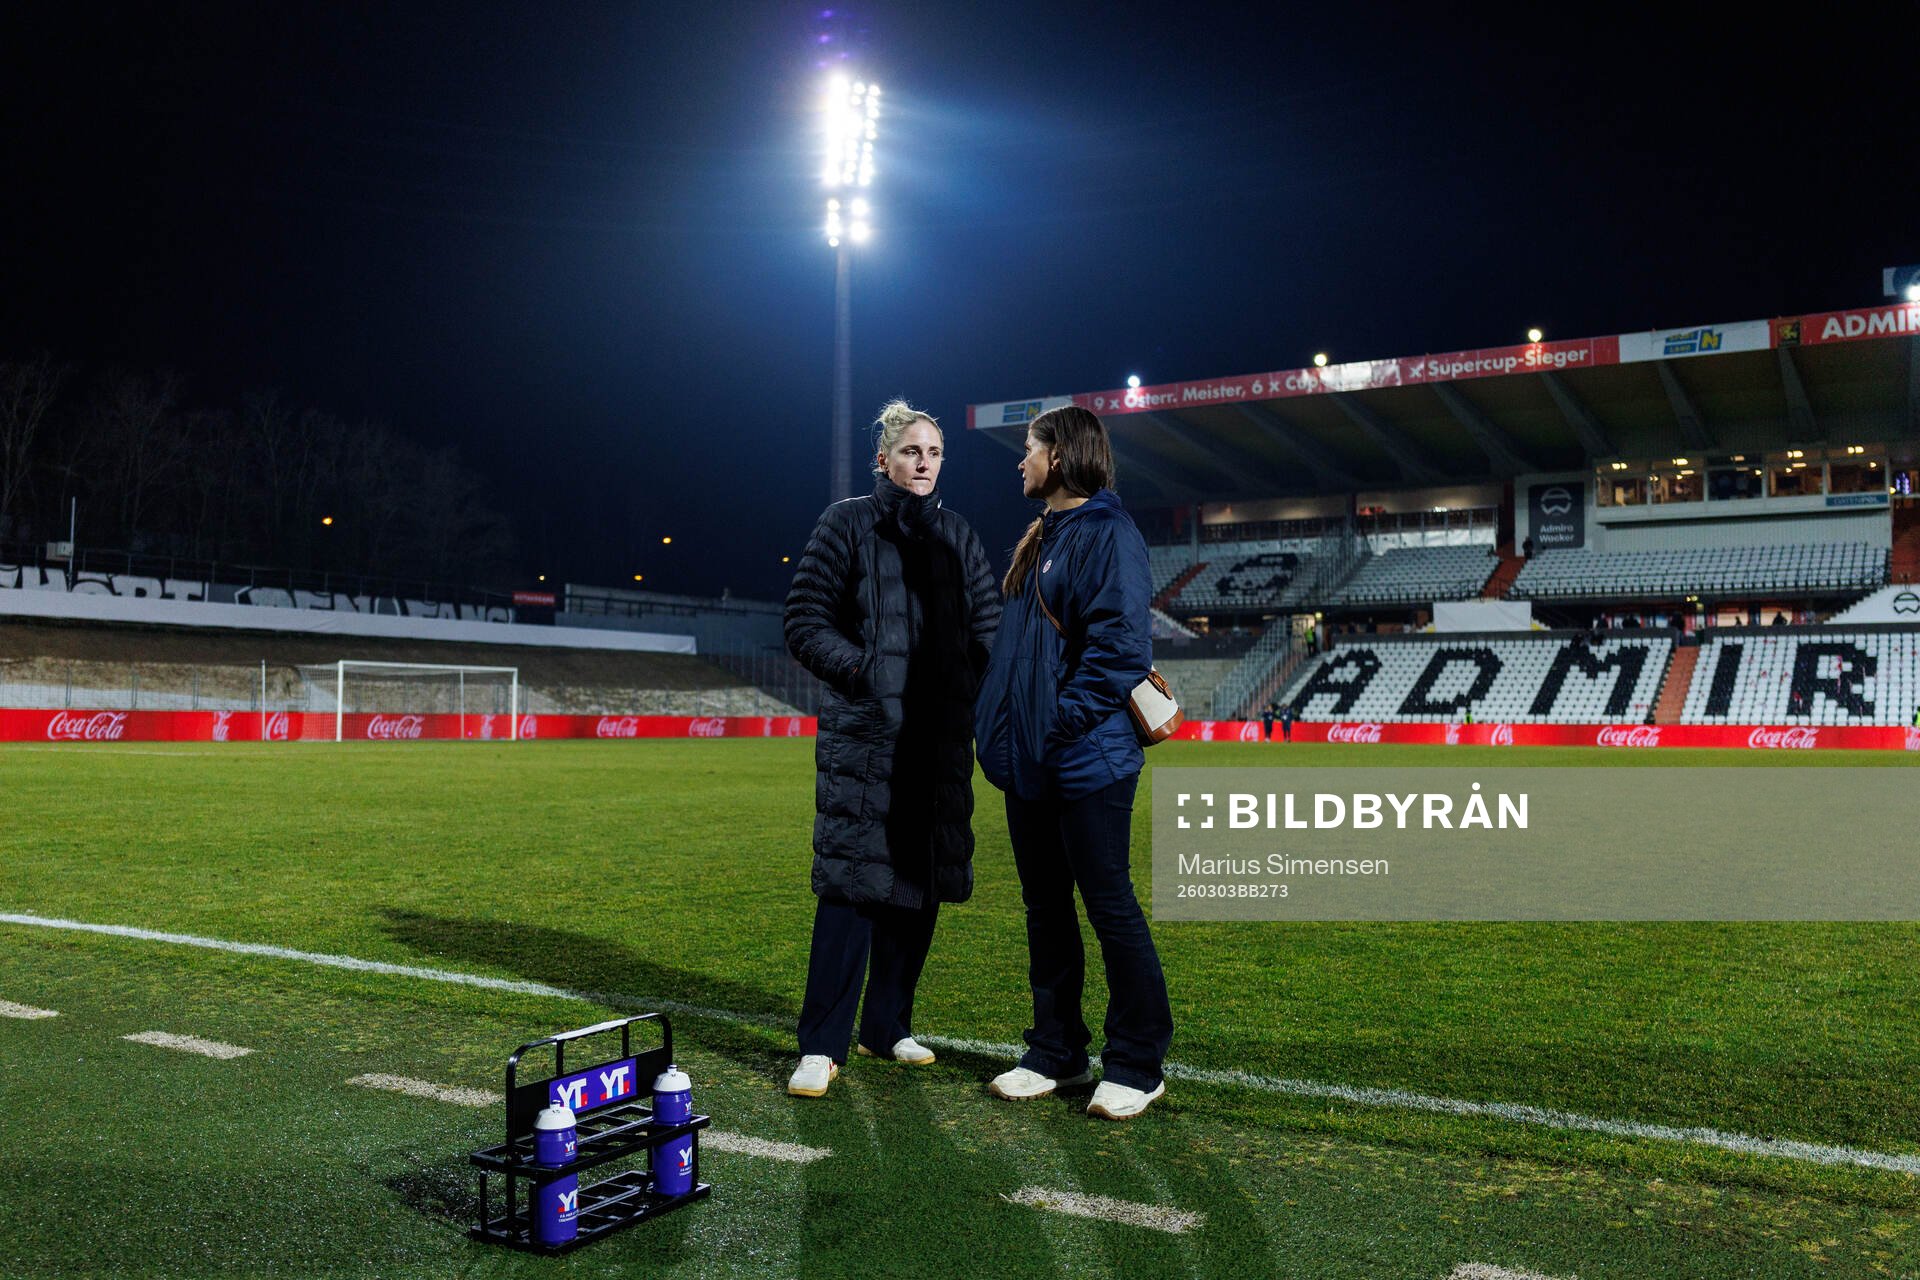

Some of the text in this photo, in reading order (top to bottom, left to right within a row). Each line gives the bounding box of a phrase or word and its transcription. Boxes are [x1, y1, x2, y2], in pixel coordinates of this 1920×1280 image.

[1821, 308, 1920, 340] ADMIR
[1094, 396, 1105, 411] 9
[1109, 398, 1120, 410] x
[1183, 383, 1246, 402] Meister,
[1252, 380, 1263, 394] 6
[1269, 380, 1280, 393] x
[1428, 346, 1588, 379] Supercup-Sieger
[1539, 533, 1574, 543] Wacker
[1541, 524, 1574, 533] Admira
[600, 1066, 629, 1099] YT
